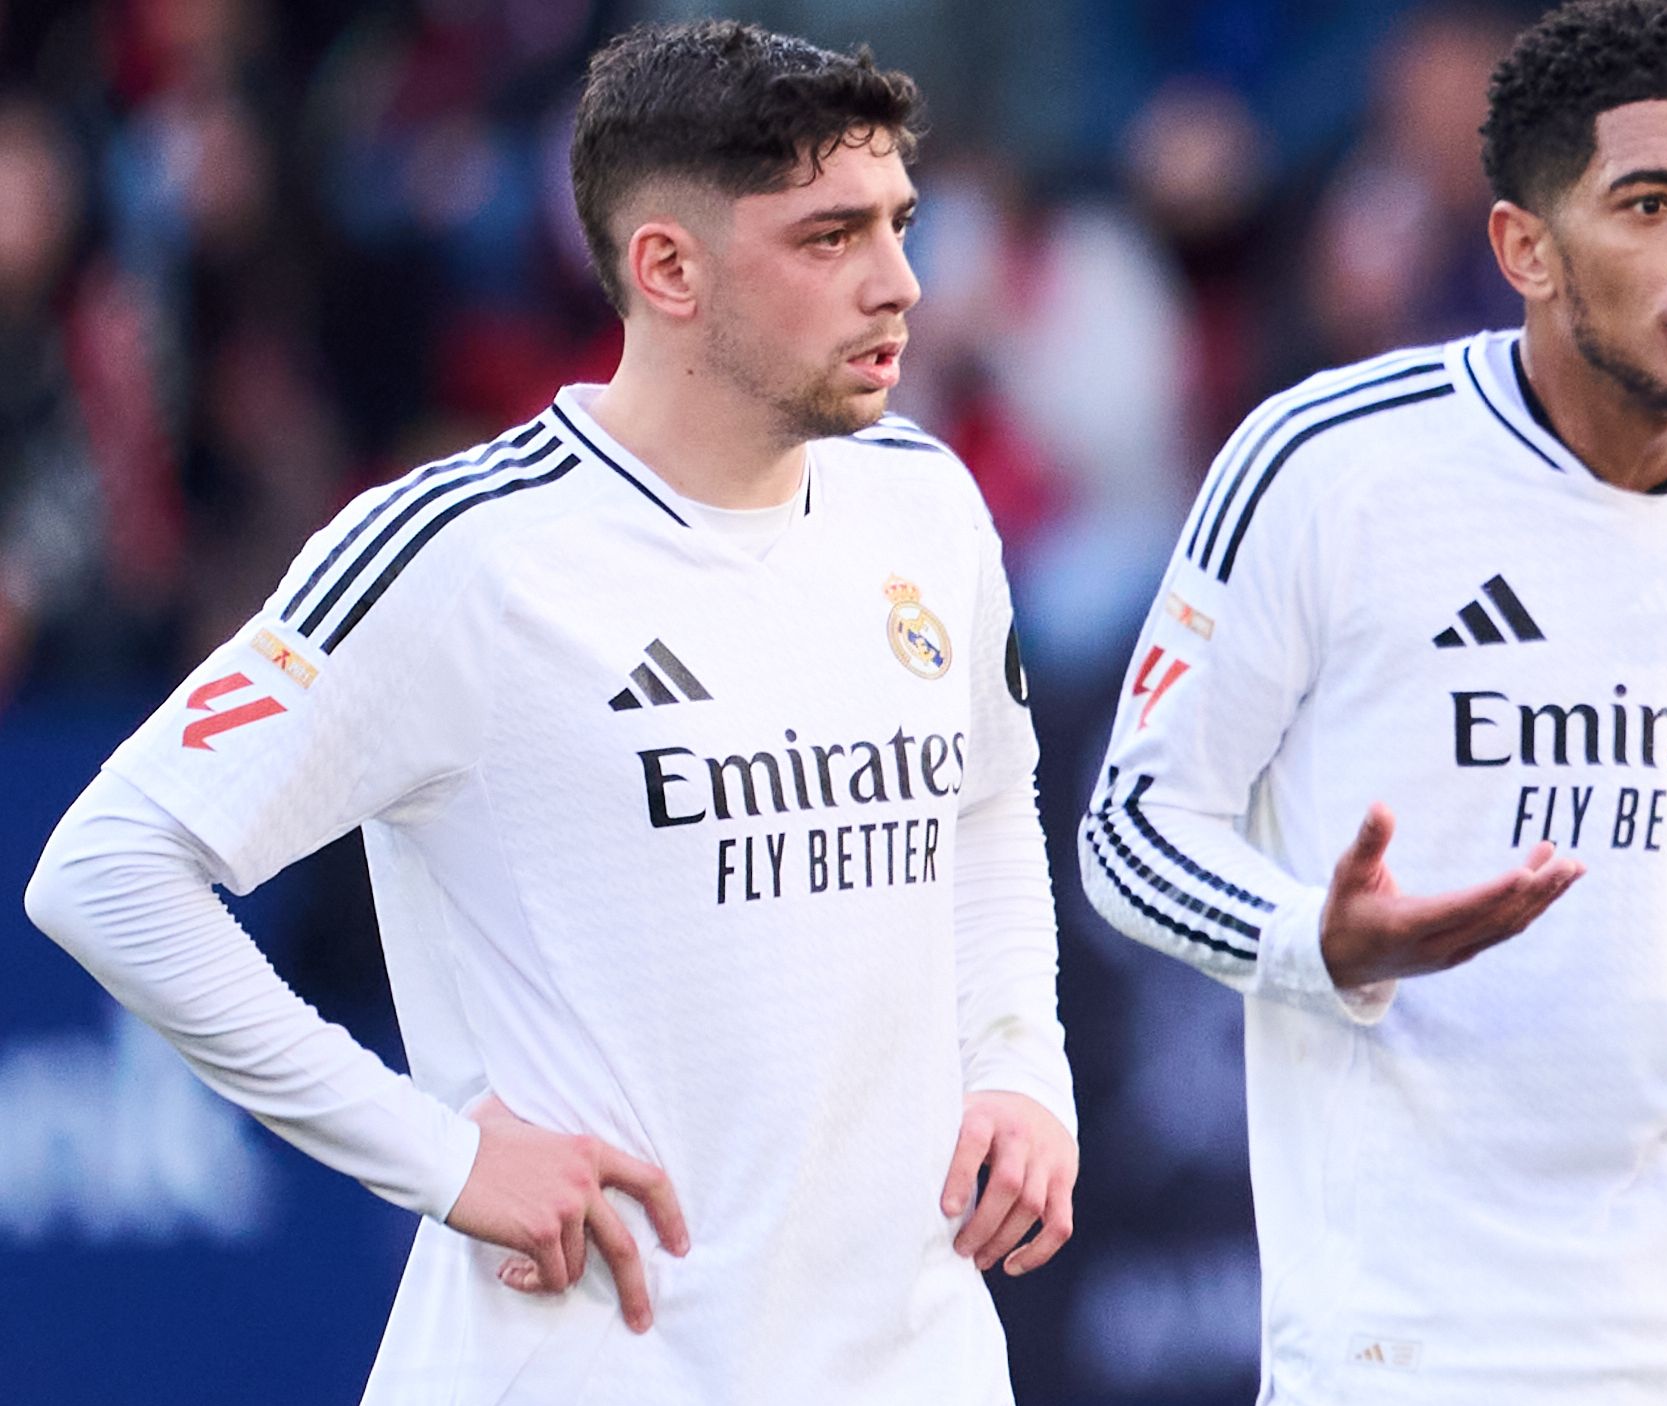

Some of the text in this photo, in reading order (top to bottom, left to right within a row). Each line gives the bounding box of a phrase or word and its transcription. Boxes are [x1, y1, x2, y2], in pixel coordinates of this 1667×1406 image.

[636, 725, 965, 829] Emirates
[1511, 785, 1595, 849] FLY
[717, 817, 940, 905] FLY BETTER
